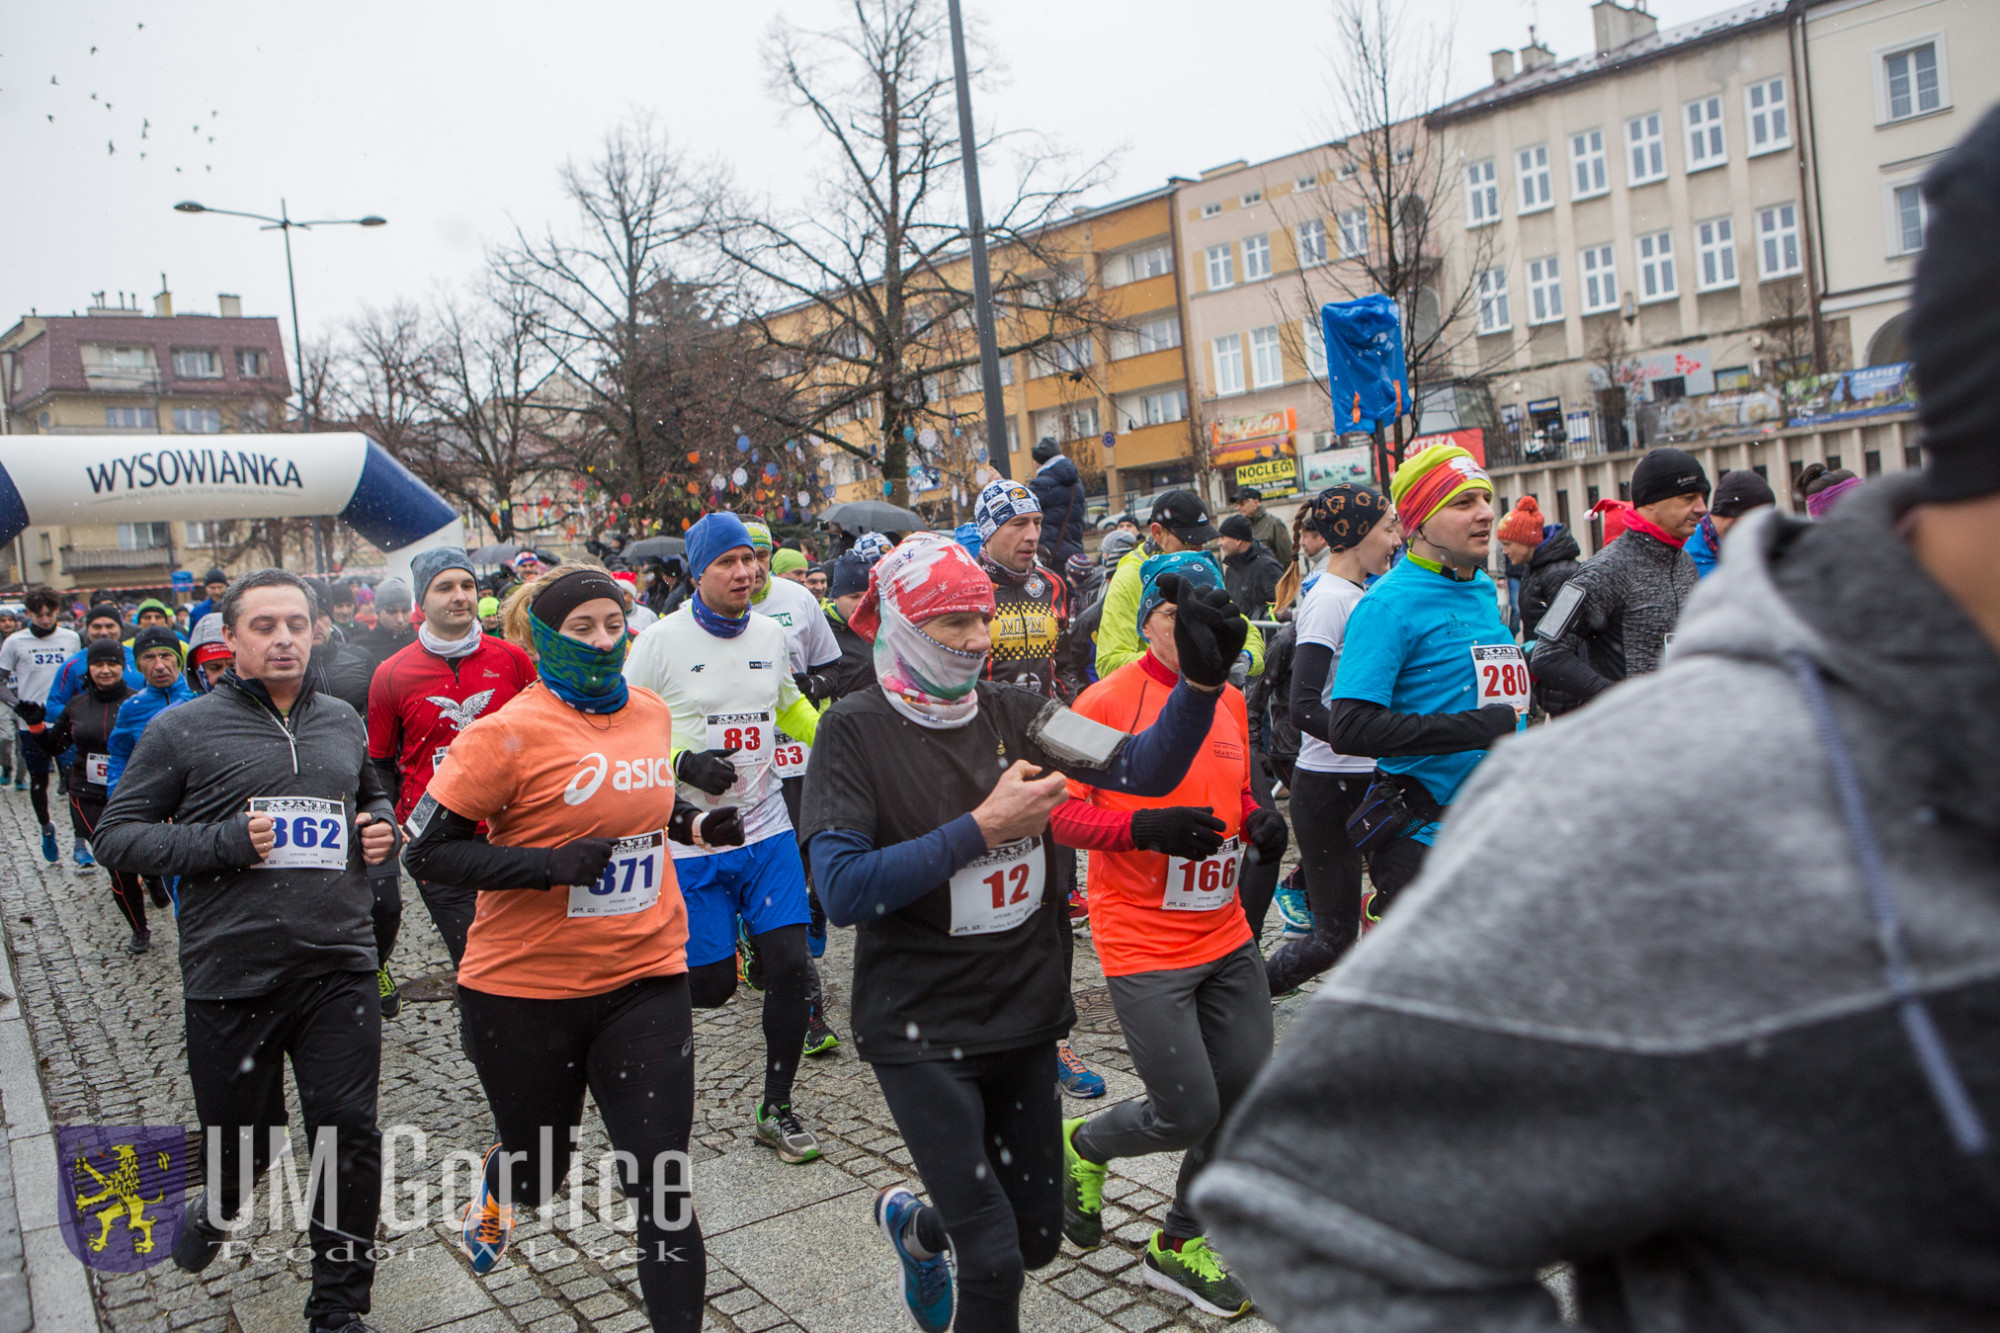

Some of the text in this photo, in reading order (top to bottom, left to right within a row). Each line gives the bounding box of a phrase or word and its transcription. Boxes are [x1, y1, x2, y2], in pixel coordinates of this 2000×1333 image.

[86, 449, 304, 494] WYSOWIANKA
[1238, 460, 1294, 479] NOCLEGI
[1000, 616, 1046, 636] MPM
[34, 653, 65, 665] 325
[1483, 664, 1528, 697] 280
[724, 727, 760, 751] 83
[774, 746, 803, 767] 63
[271, 816, 341, 850] 362
[588, 854, 654, 896] 371
[983, 863, 1030, 910] 12
[1178, 857, 1236, 893] 166
